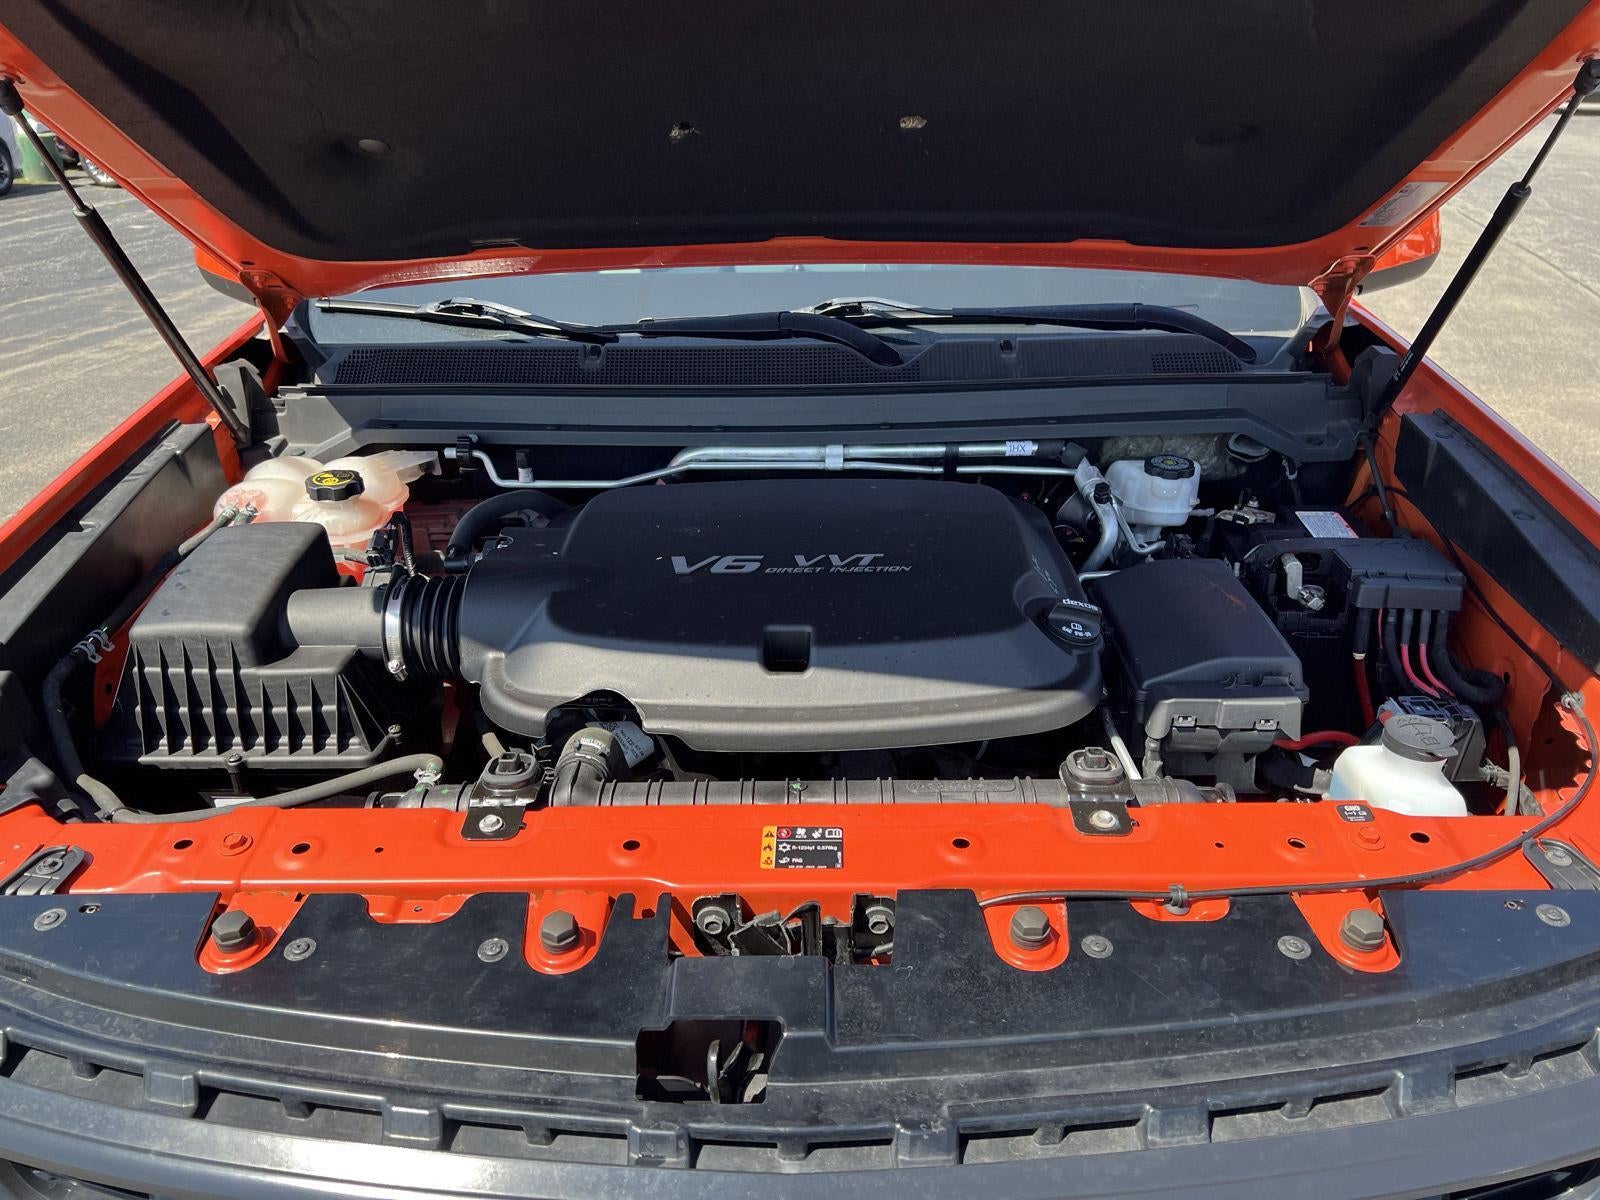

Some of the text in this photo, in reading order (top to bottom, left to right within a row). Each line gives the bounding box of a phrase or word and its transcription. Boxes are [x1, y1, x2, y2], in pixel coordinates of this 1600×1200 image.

[671, 555, 764, 574] V6
[794, 553, 884, 566] VVT
[829, 565, 912, 573] INJECTION
